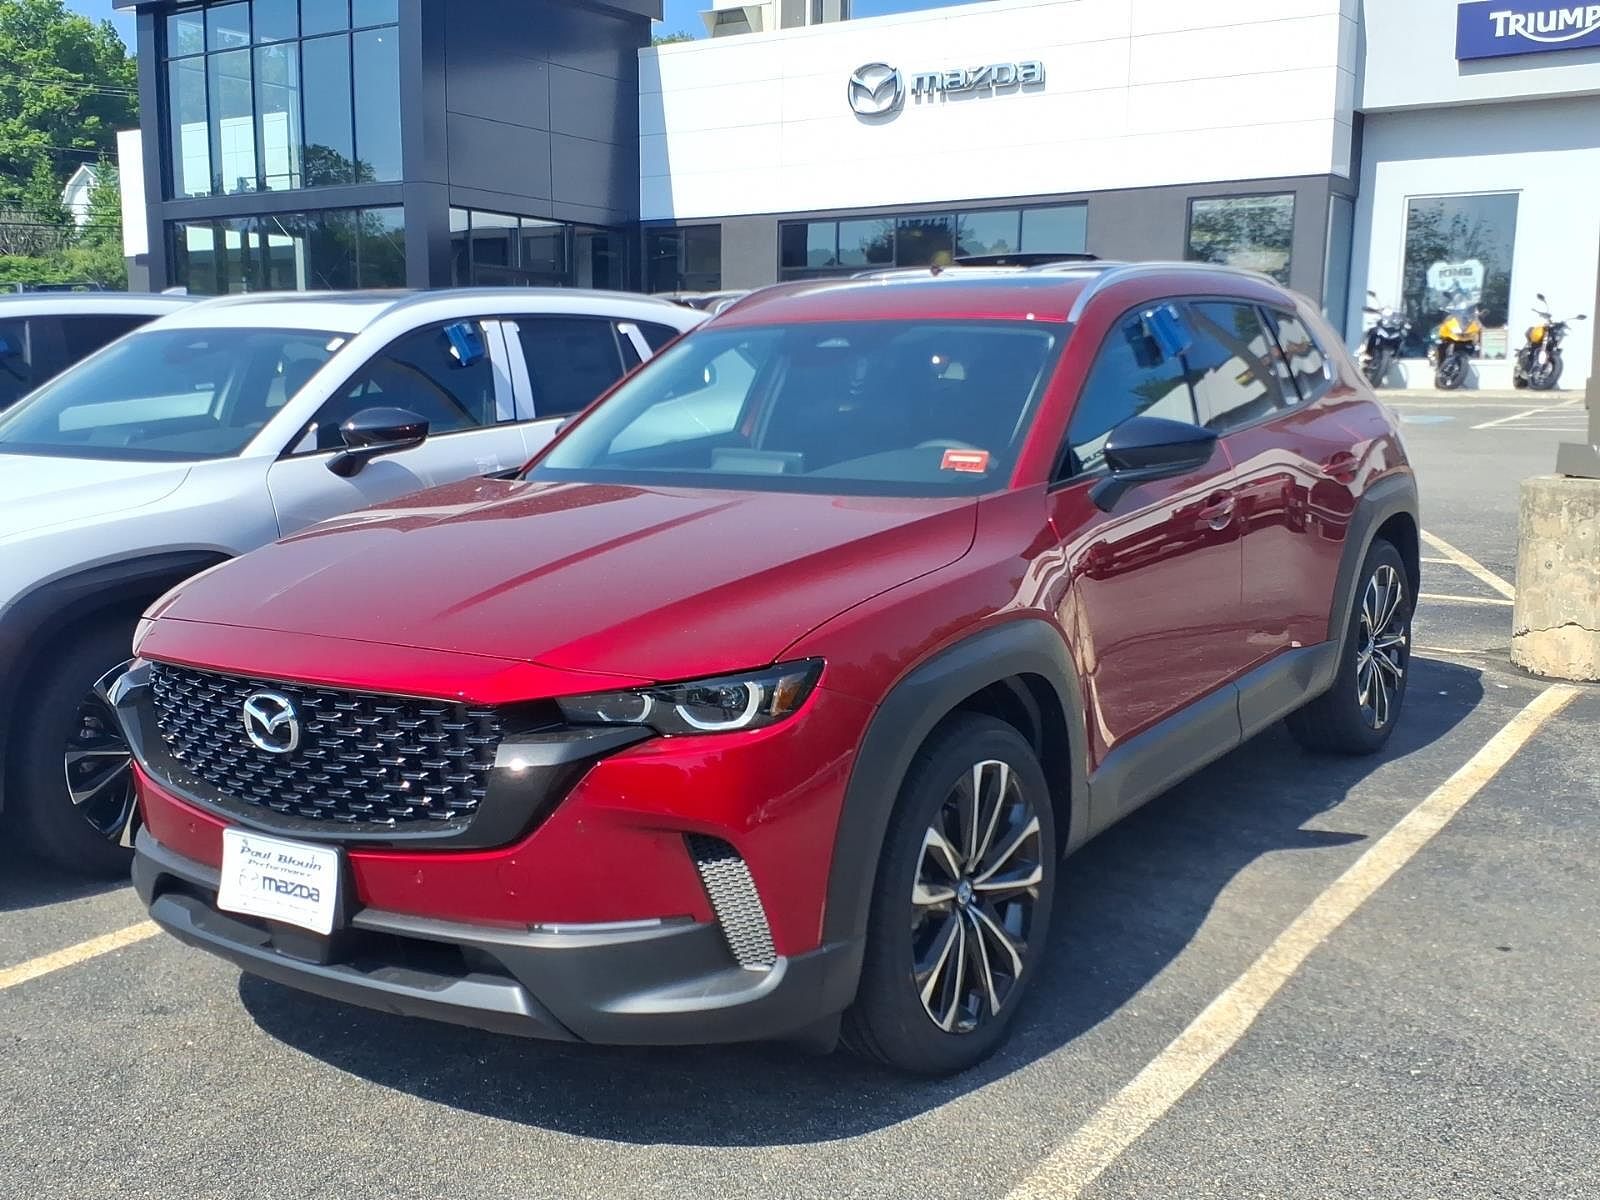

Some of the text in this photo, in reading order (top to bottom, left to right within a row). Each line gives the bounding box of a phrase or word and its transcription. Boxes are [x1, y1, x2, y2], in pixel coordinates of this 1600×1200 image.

[911, 60, 1045, 97] mazda
[240, 846, 322, 871] Paul Blouin
[261, 876, 320, 903] mazda
